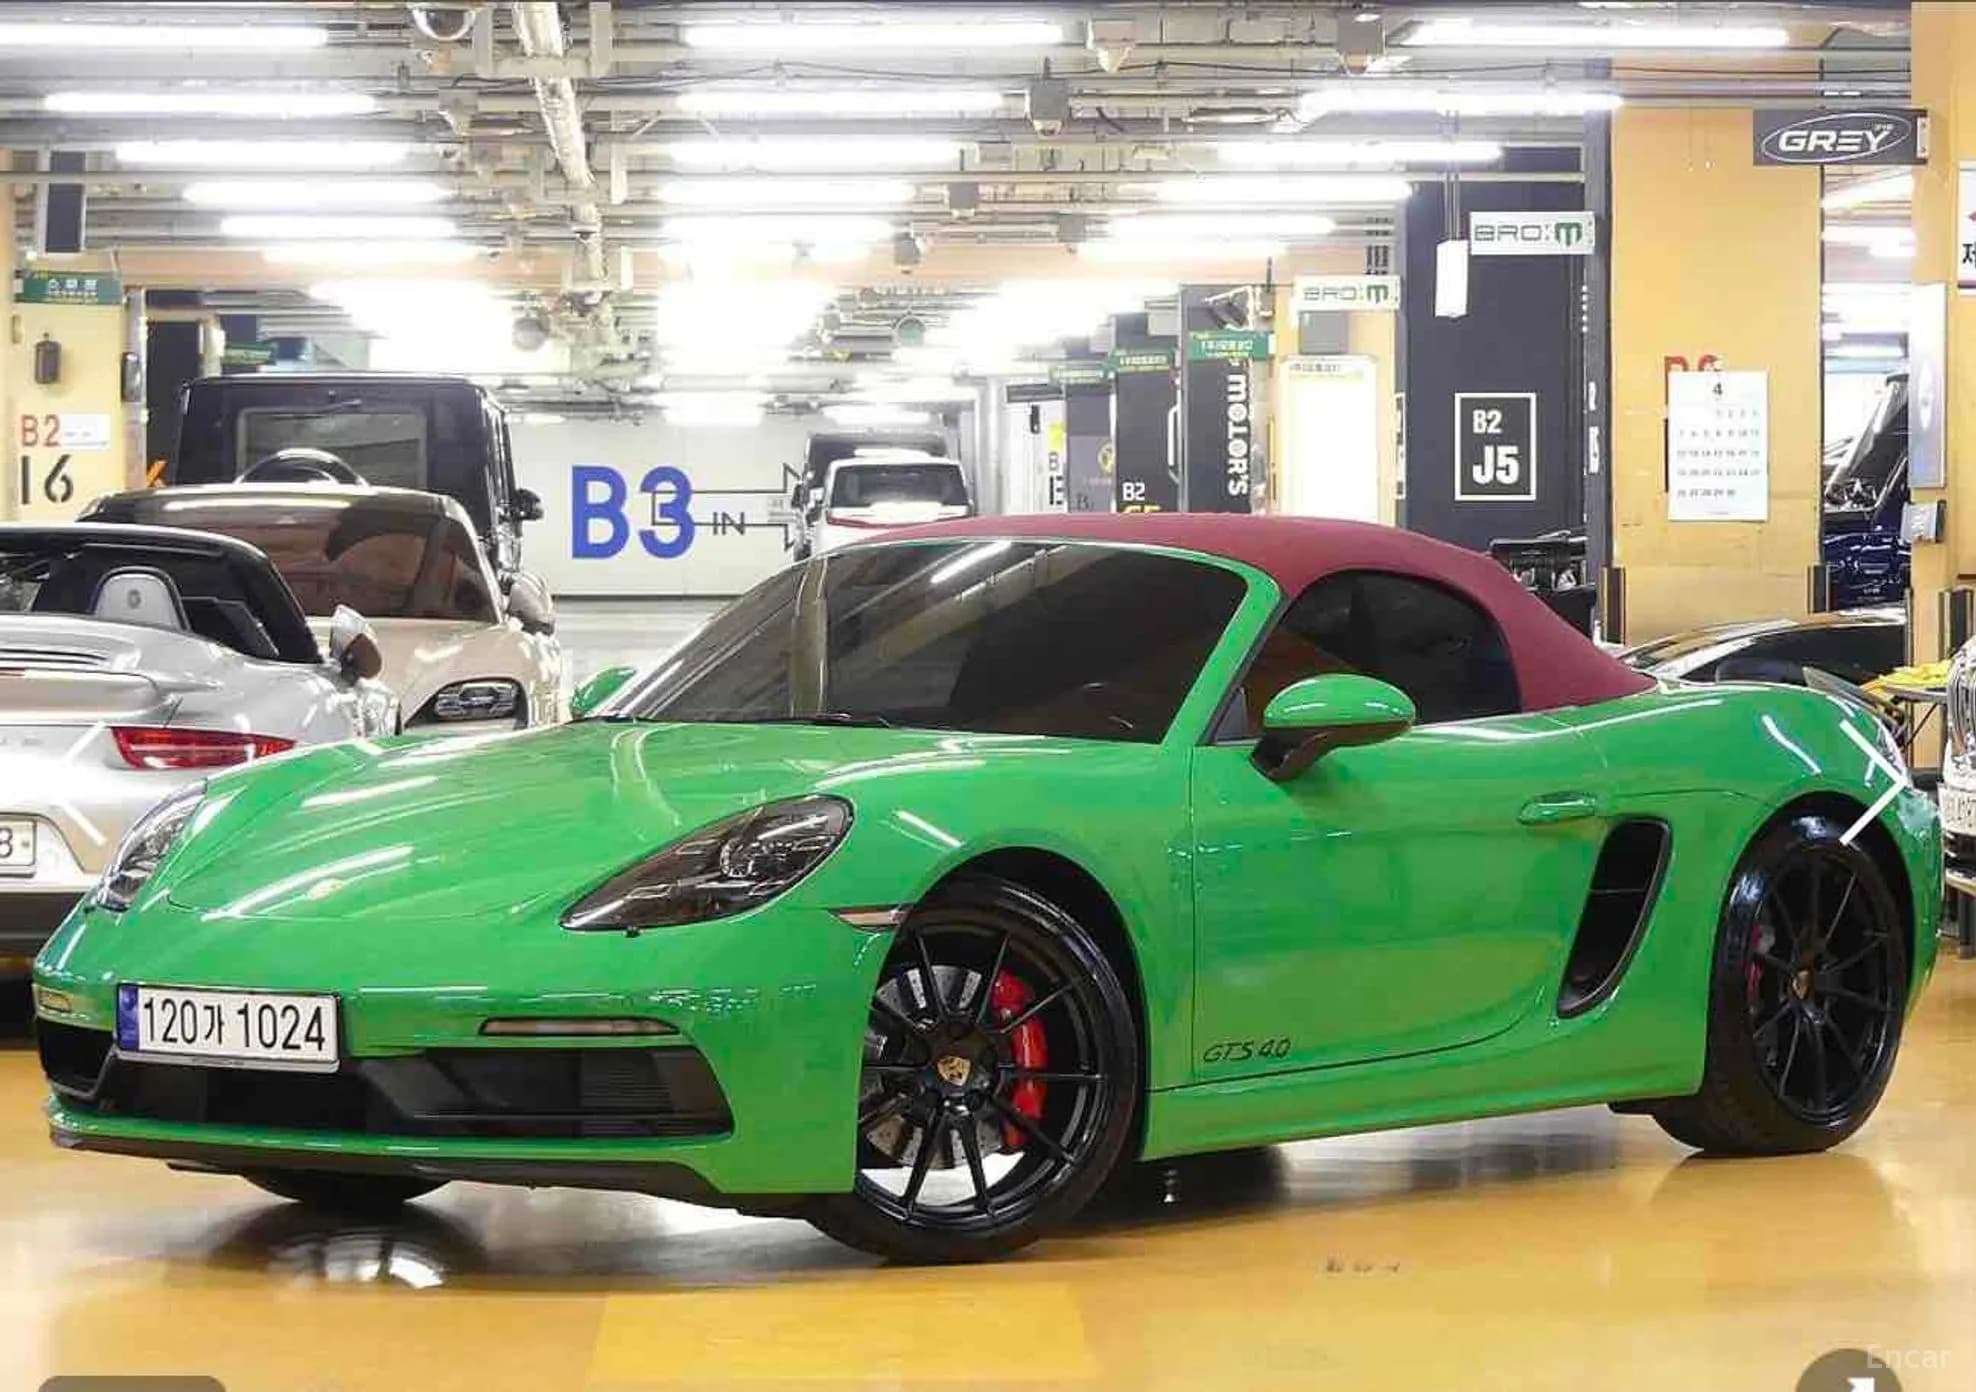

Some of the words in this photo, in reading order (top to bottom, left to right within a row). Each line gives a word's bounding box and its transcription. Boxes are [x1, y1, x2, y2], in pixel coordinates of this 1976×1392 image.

[1778, 130, 1890, 152] GREY
[21, 414, 60, 447] B2
[1473, 409, 1503, 433] B2
[1473, 445, 1519, 484] J5
[21, 454, 73, 504] 16
[1122, 482, 1145, 501] B2
[572, 466, 694, 559] B3
[713, 512, 745, 535] IN
[144, 997, 224, 1045] 120가
[237, 1003, 325, 1051] 1024
[1203, 1040, 1254, 1062] GTS
